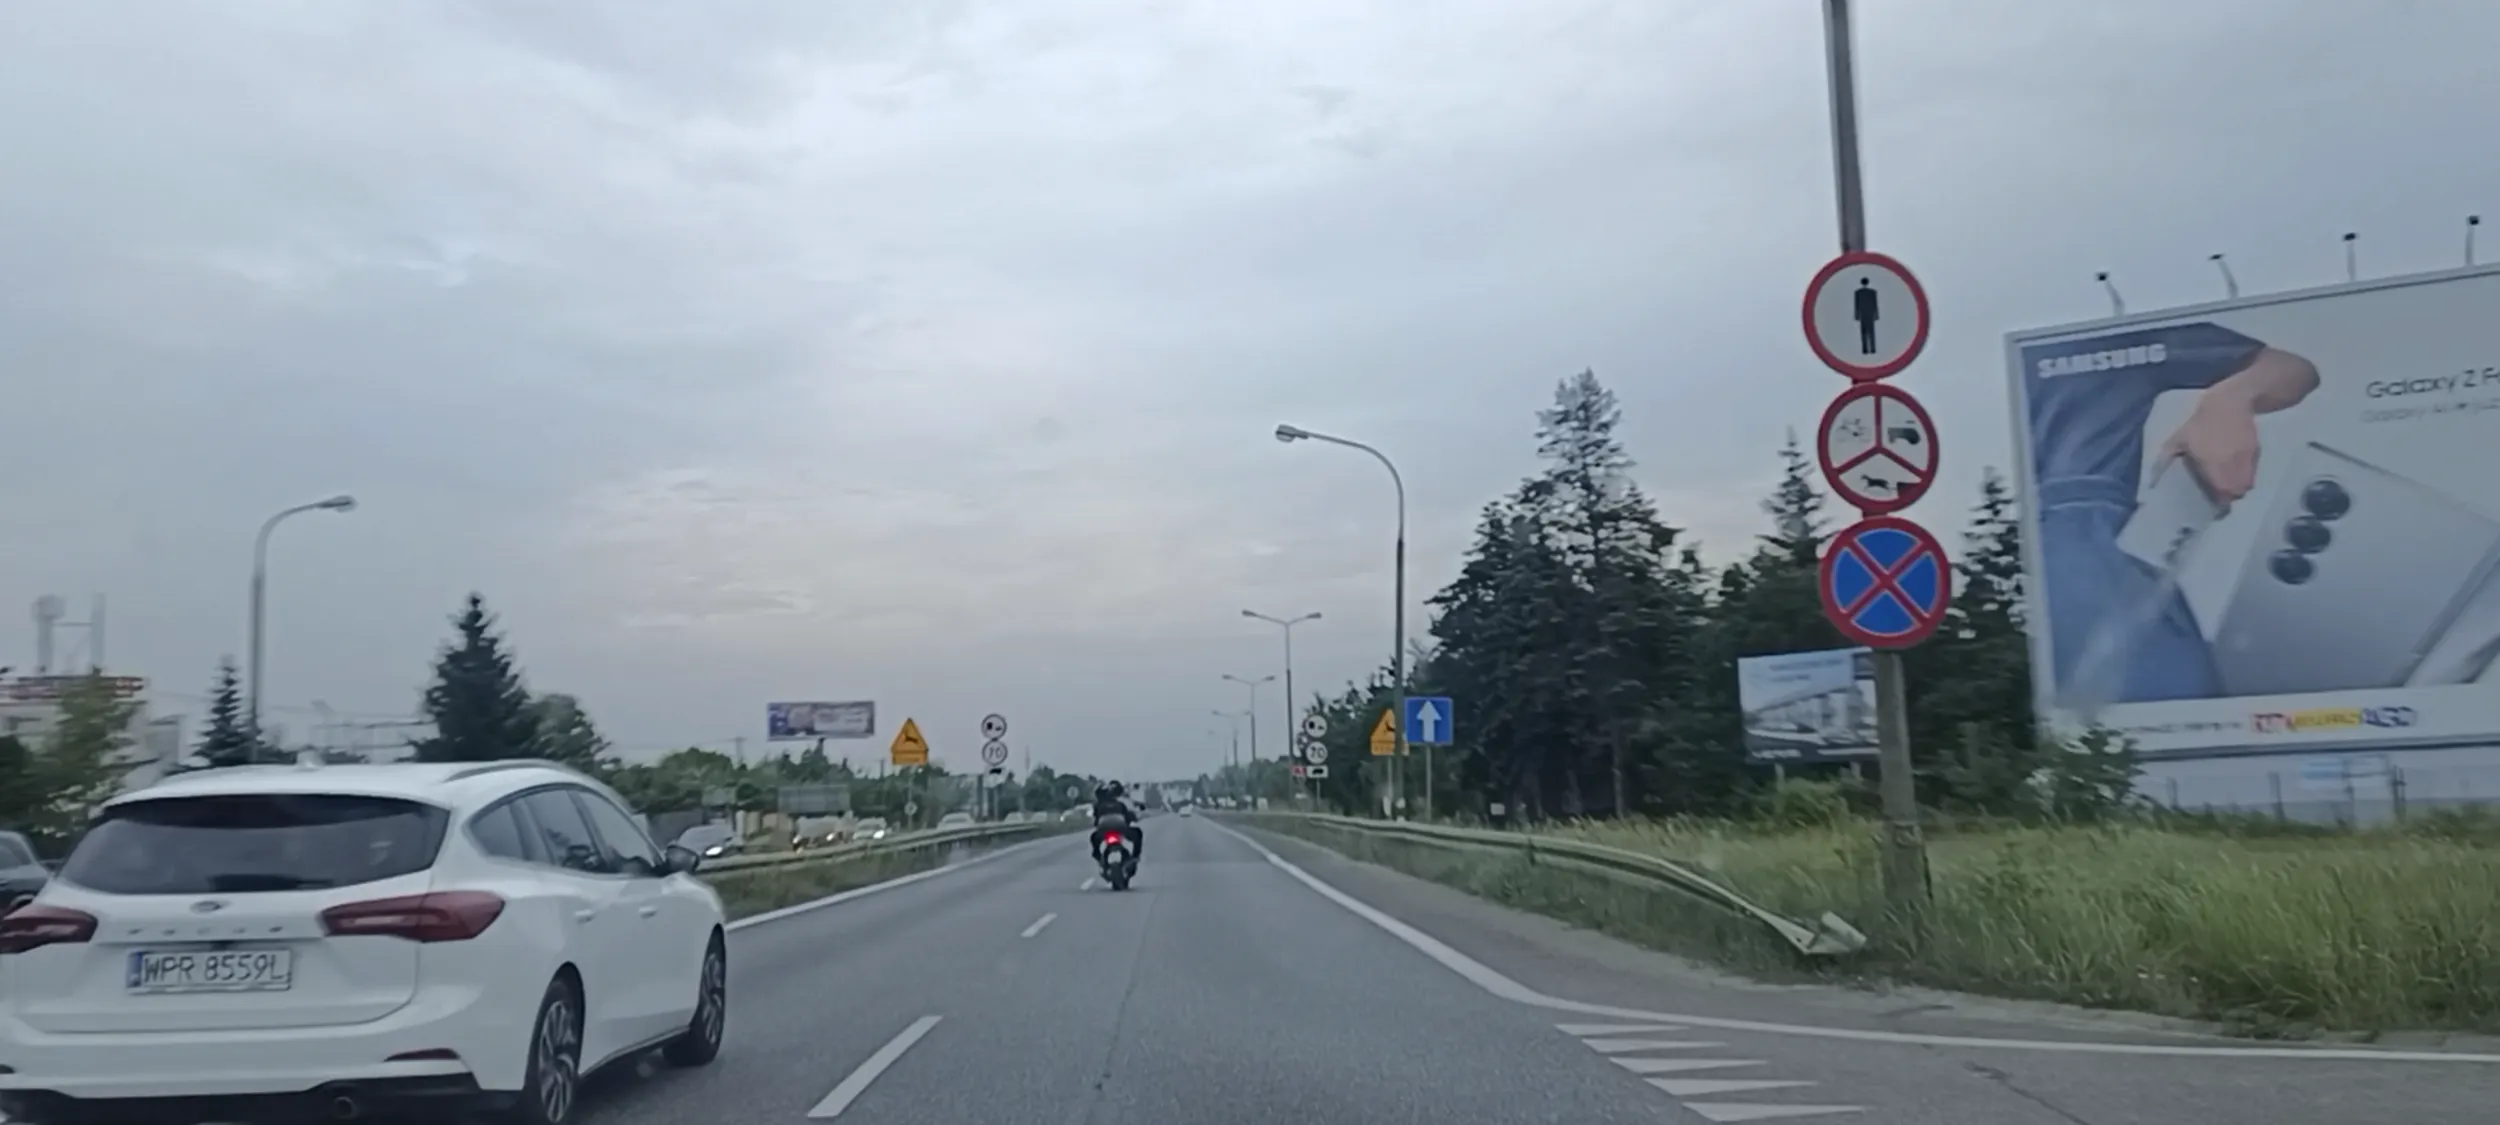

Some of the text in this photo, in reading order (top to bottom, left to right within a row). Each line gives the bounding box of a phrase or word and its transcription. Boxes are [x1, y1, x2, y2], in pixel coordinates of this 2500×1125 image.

[2038, 344, 2167, 379] SAMSUNG
[2365, 374, 2458, 399] Galaxy
[2463, 369, 2477, 388] Z
[988, 746, 1003, 759] 70
[1310, 746, 1326, 759] 70
[144, 954, 283, 982] WPR 8559L
